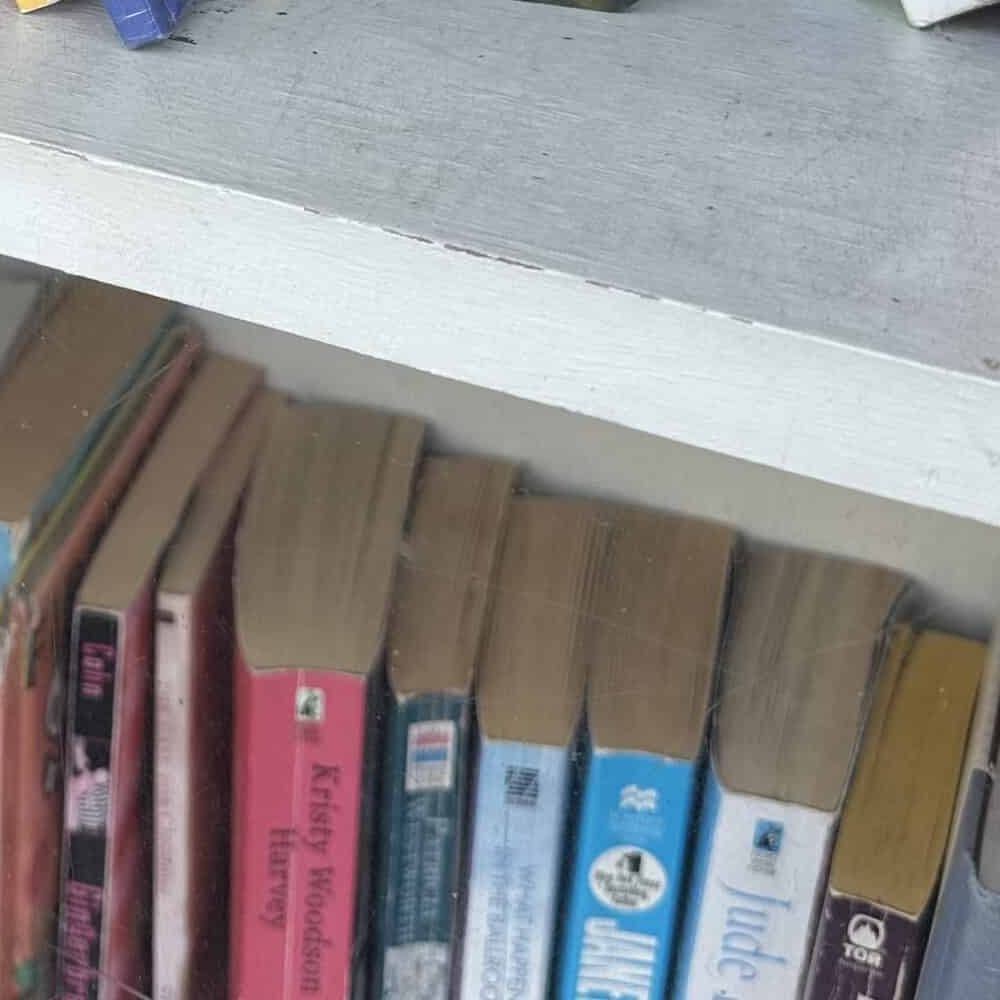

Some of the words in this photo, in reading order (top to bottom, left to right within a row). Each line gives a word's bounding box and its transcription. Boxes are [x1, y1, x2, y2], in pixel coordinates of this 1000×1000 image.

[303, 763, 342, 856] Kristy
[258, 826, 298, 931] Harvey
[298, 866, 337, 994] Woodson
[718, 880, 793, 982] Jude
[842, 942, 882, 968] TOR
